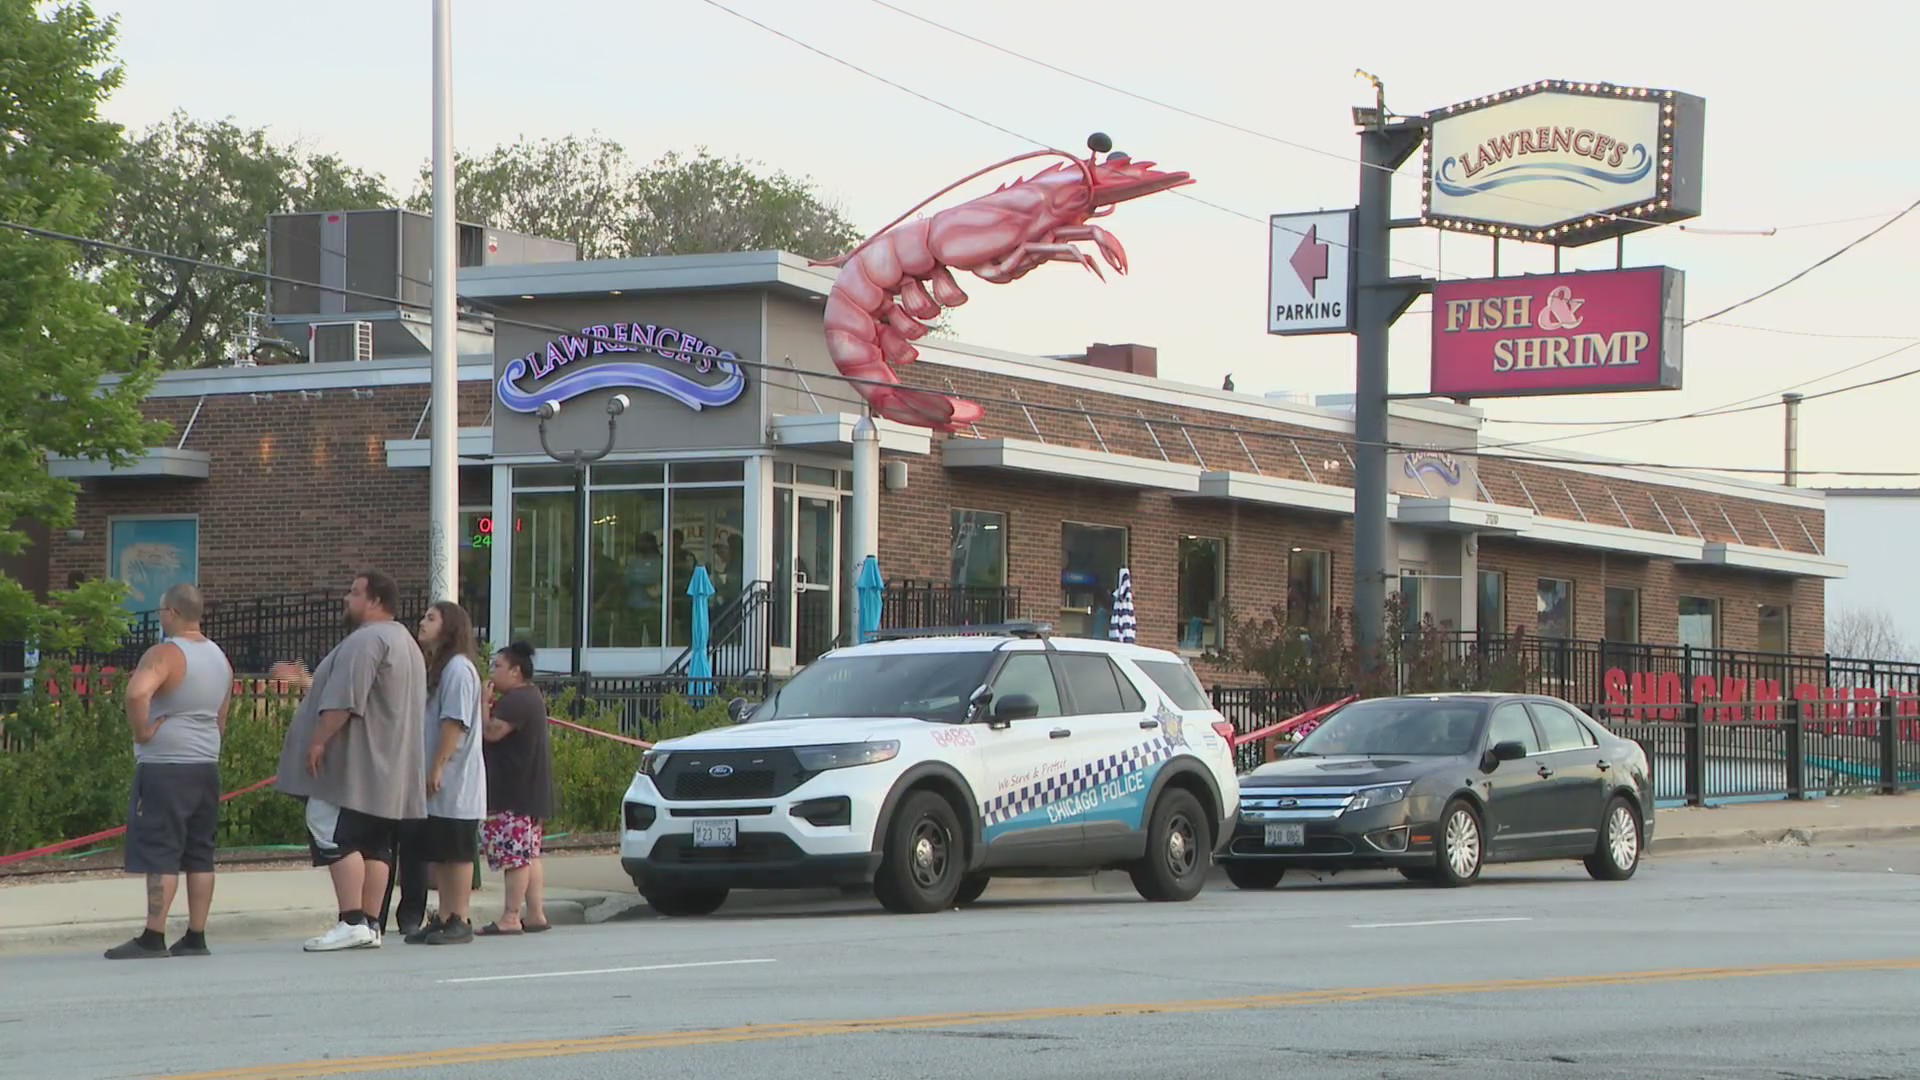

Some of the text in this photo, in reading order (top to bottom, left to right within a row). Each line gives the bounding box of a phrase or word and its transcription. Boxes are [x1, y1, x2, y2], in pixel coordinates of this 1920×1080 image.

[1459, 125, 1630, 178] LAWRENCE'S
[1276, 302, 1342, 321] PARKING
[1443, 285, 1585, 332] FISH &
[526, 322, 719, 380] LAWRENCE'S
[1493, 331, 1650, 372] SHRIMP
[472, 534, 491, 548] 24
[1011, 771, 1030, 787] Serve
[1046, 772, 1145, 824] CHICAGO POLICE
